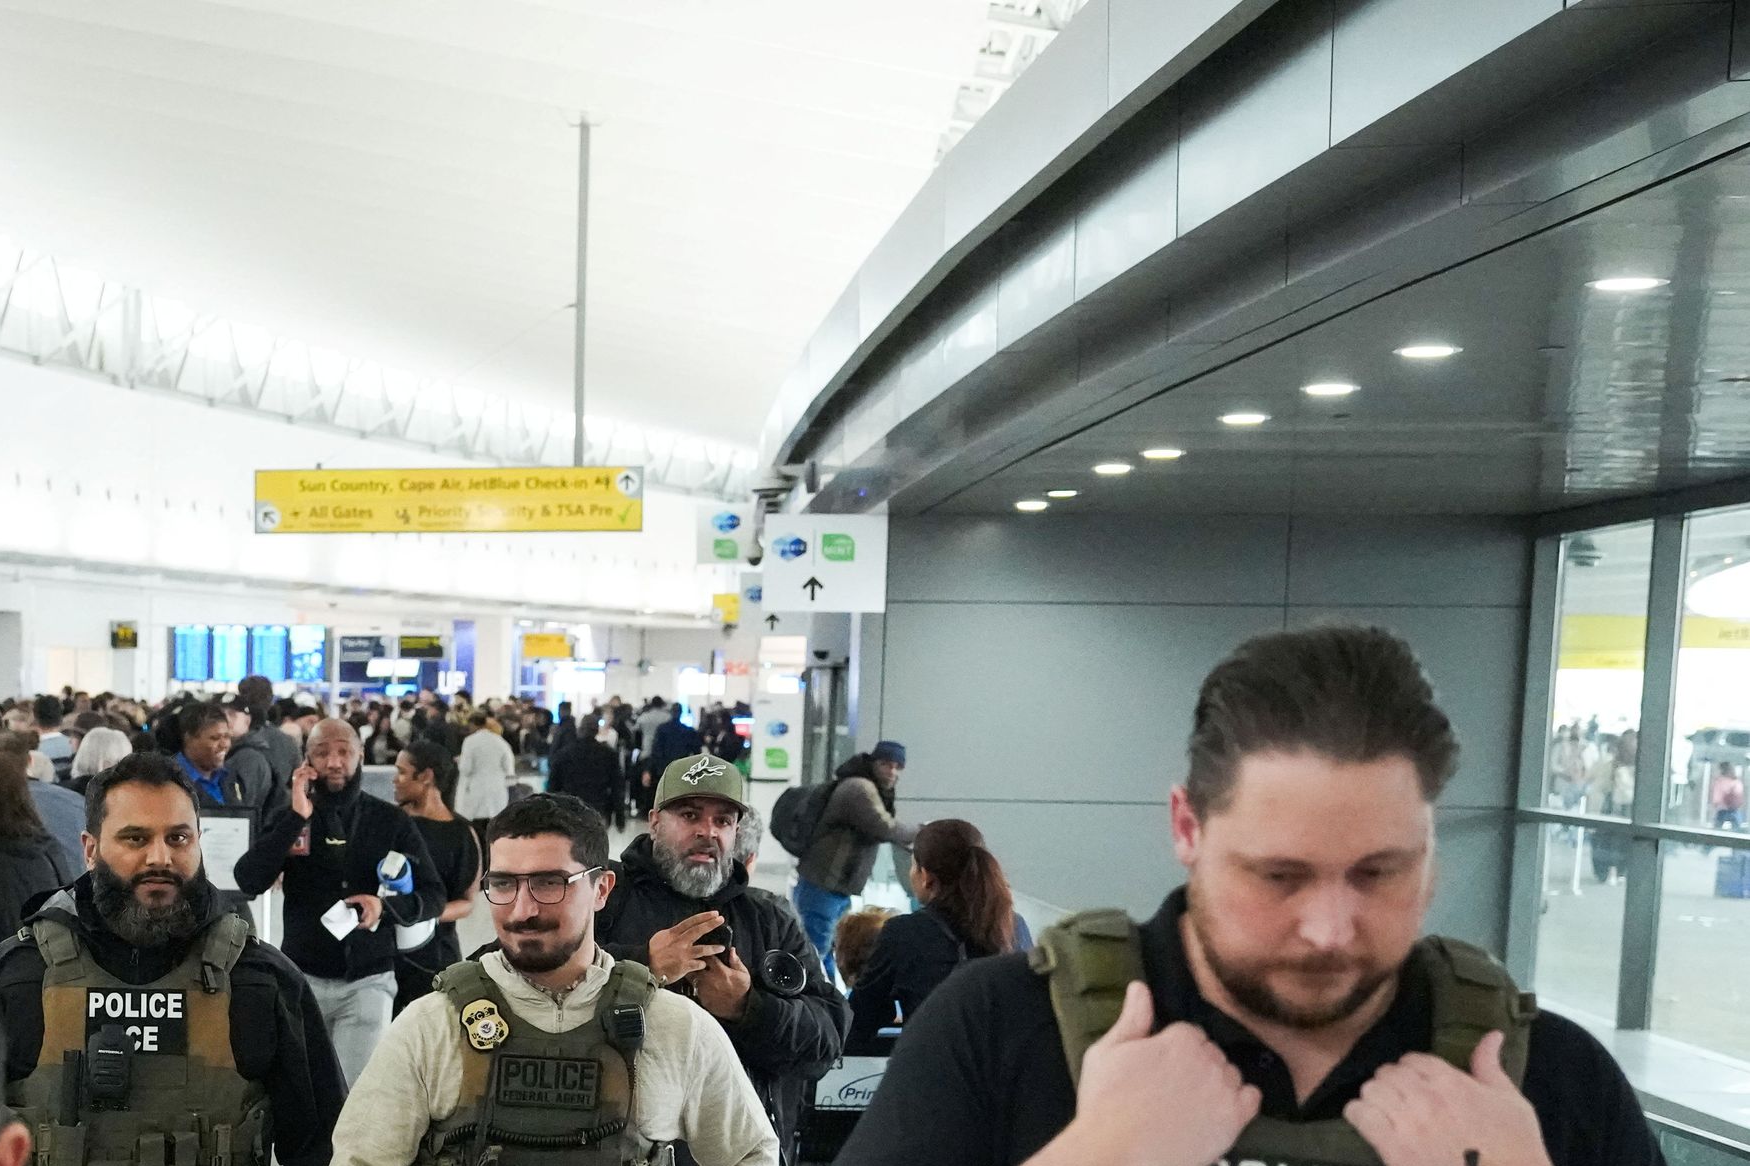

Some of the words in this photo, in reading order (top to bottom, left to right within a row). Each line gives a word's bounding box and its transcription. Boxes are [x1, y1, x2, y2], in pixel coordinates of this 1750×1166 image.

[299, 479, 326, 492] Sun
[400, 478, 435, 493] Cape
[525, 476, 588, 490] Check-in
[309, 506, 328, 518] All
[332, 506, 373, 519] Gates
[418, 505, 471, 518] Priority
[476, 504, 534, 519] Serity
[557, 504, 585, 516] TSA
[590, 504, 614, 516] Pre
[88, 992, 184, 1019] POLICE
[124, 1025, 159, 1052] CE
[504, 1060, 595, 1092] POLICE
